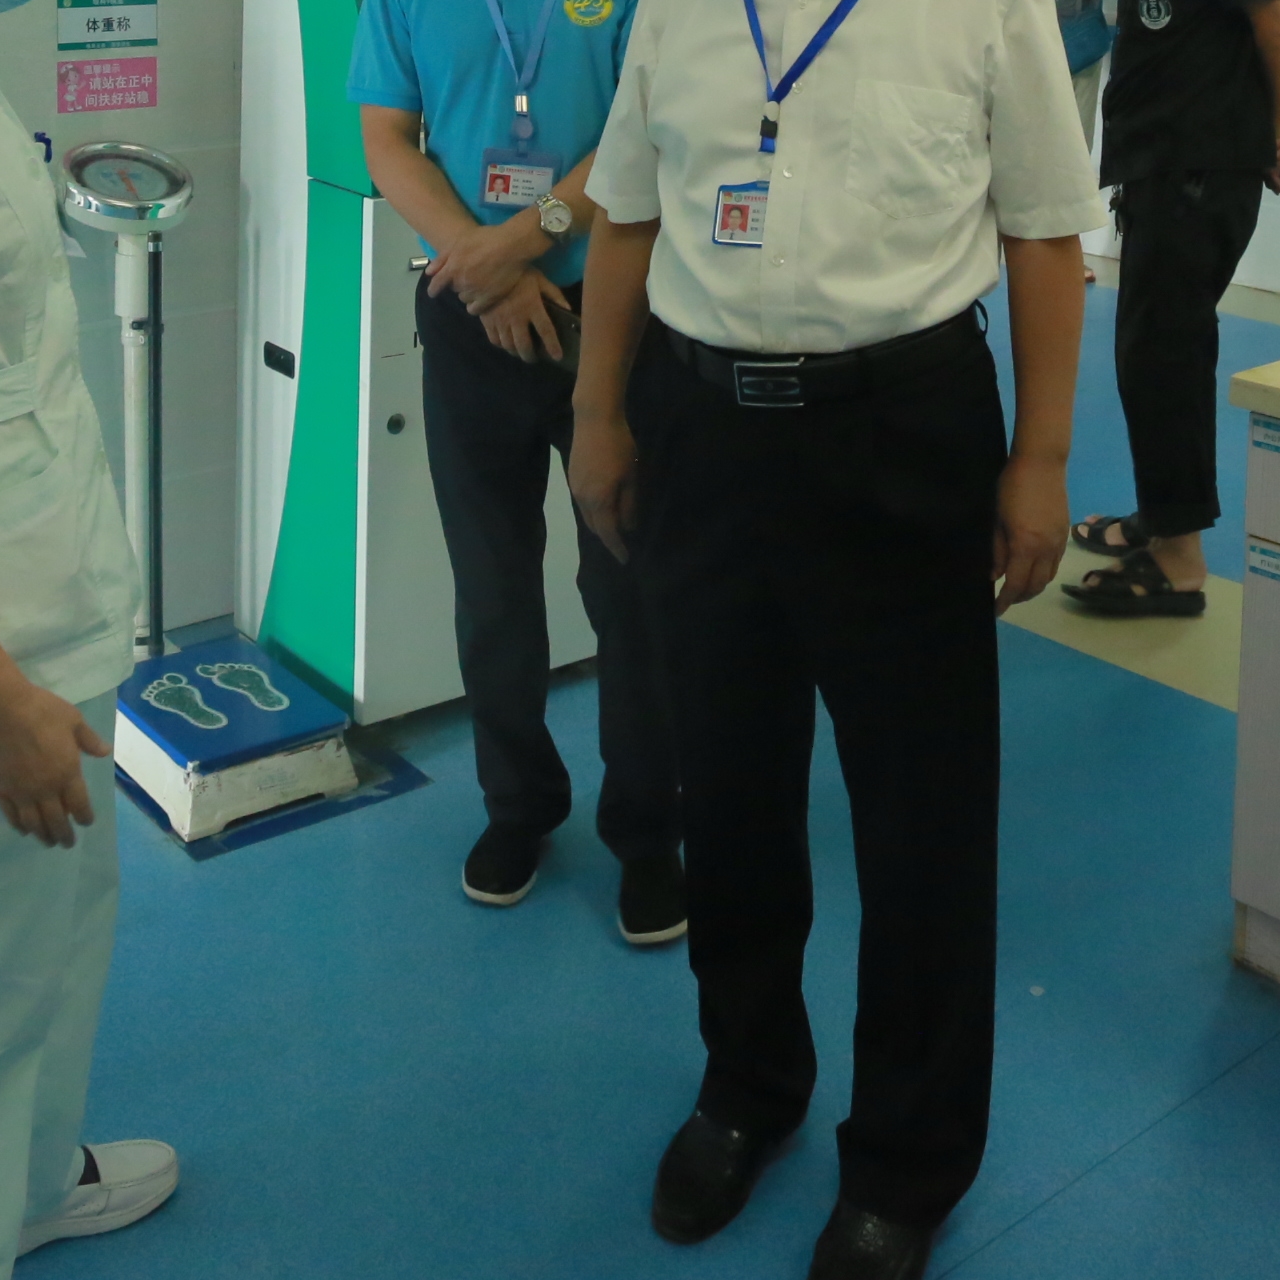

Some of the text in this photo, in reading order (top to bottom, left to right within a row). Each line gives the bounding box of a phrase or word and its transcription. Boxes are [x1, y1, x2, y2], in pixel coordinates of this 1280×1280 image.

[85, 16, 131, 33] 体重称
[89, 74, 153, 90] 请站在正中
[85, 91, 149, 107] 间扶好站稳
